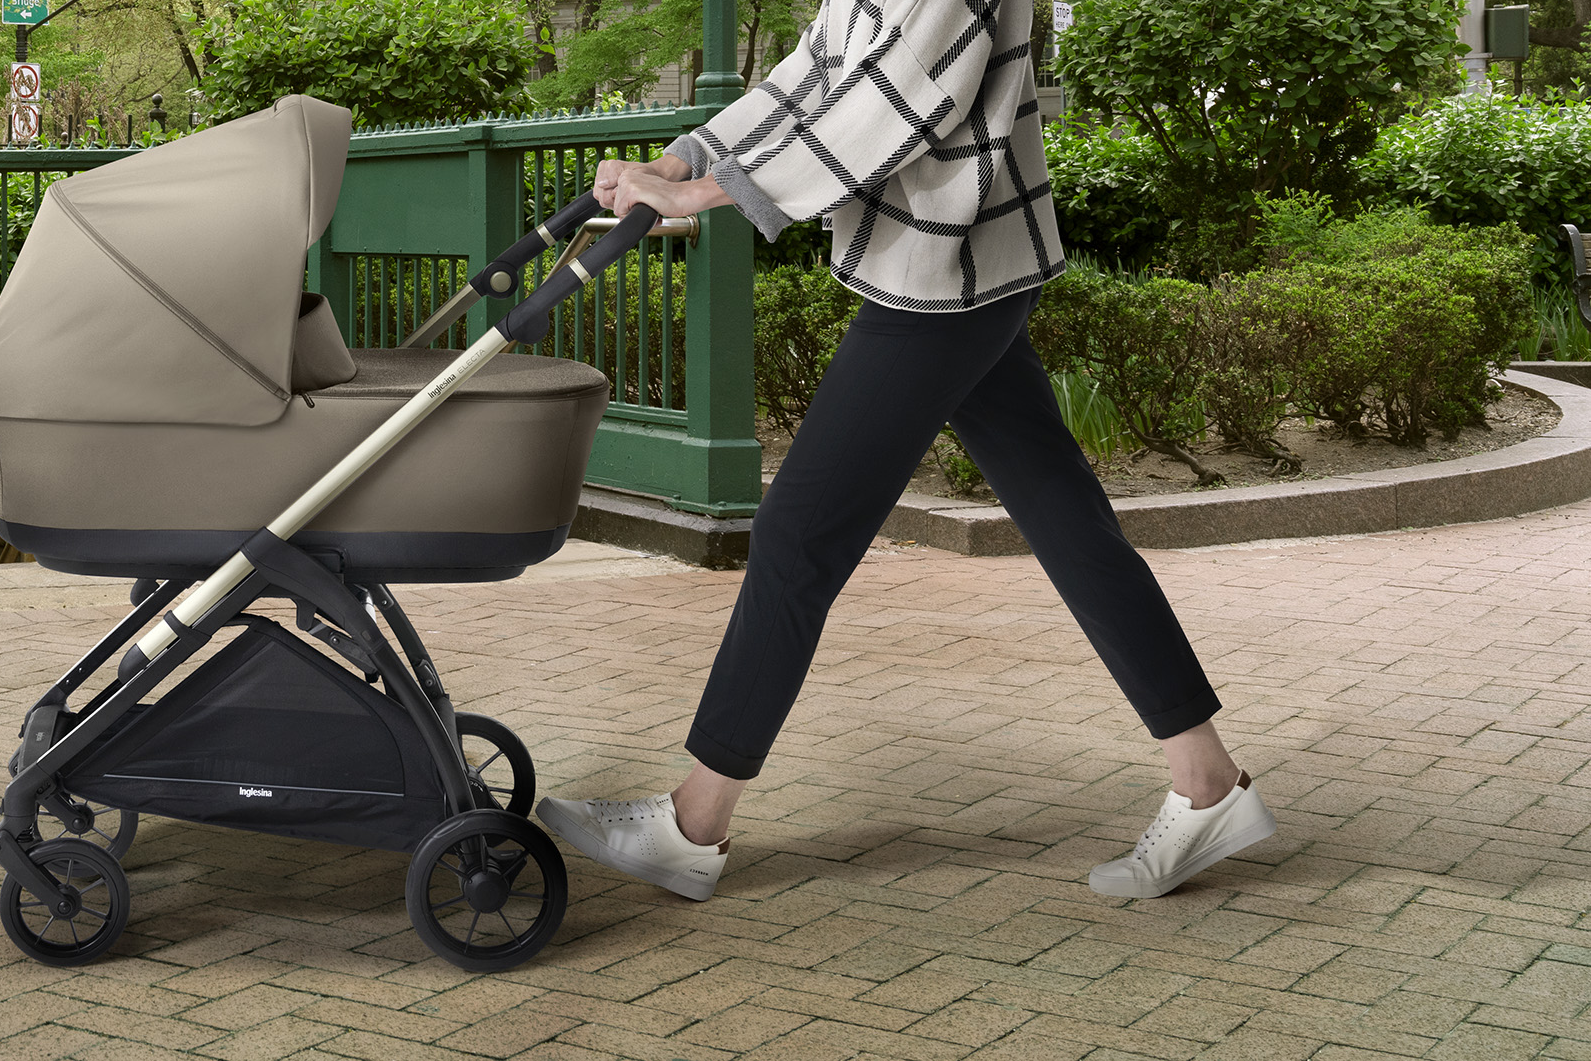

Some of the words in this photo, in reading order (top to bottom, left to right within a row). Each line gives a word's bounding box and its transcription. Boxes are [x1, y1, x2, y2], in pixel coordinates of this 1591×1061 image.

[1055, 6, 1071, 19] STOP
[427, 373, 457, 399] Inglesina
[457, 349, 486, 375] ELECTA
[238, 786, 273, 798] Inglesina
